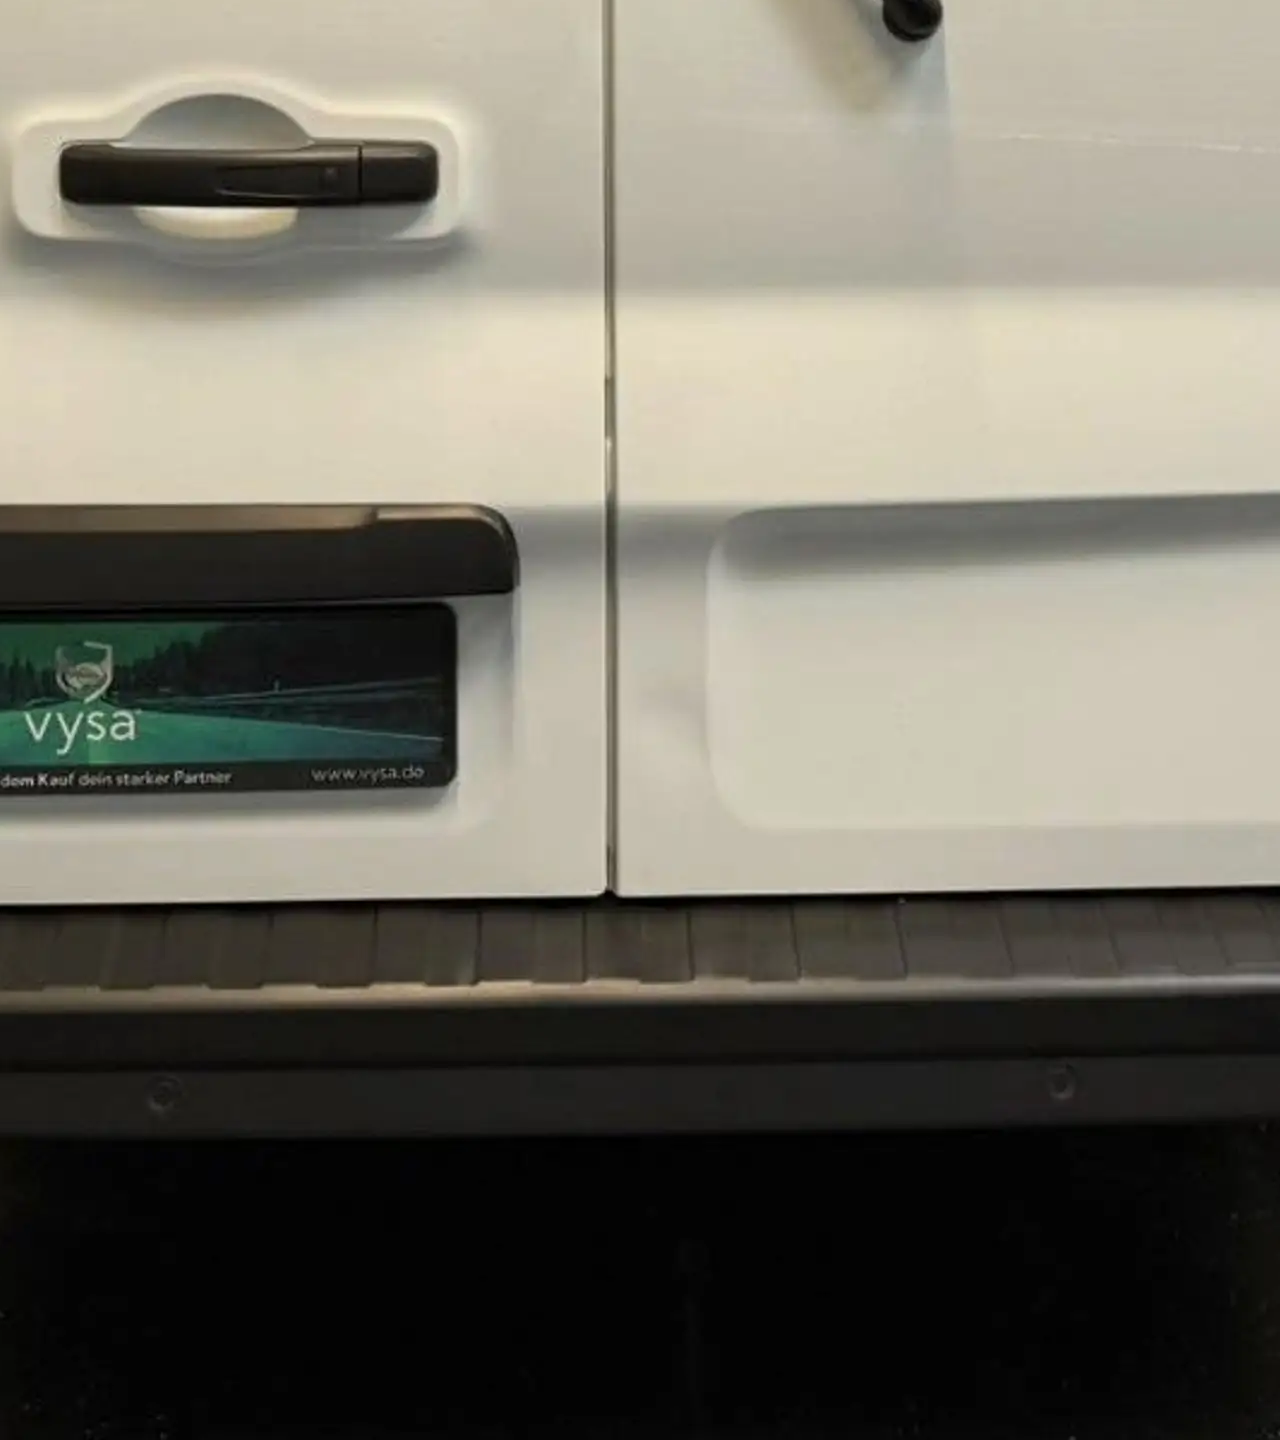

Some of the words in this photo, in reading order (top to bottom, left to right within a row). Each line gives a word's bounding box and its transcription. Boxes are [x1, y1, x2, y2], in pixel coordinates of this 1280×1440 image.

[24, 709, 136, 756] vysa
[0, 772, 35, 788] dem
[38, 771, 75, 787] Kauf
[78, 771, 113, 787] dein
[115, 770, 170, 786] starker
[173, 769, 233, 785] Partner
